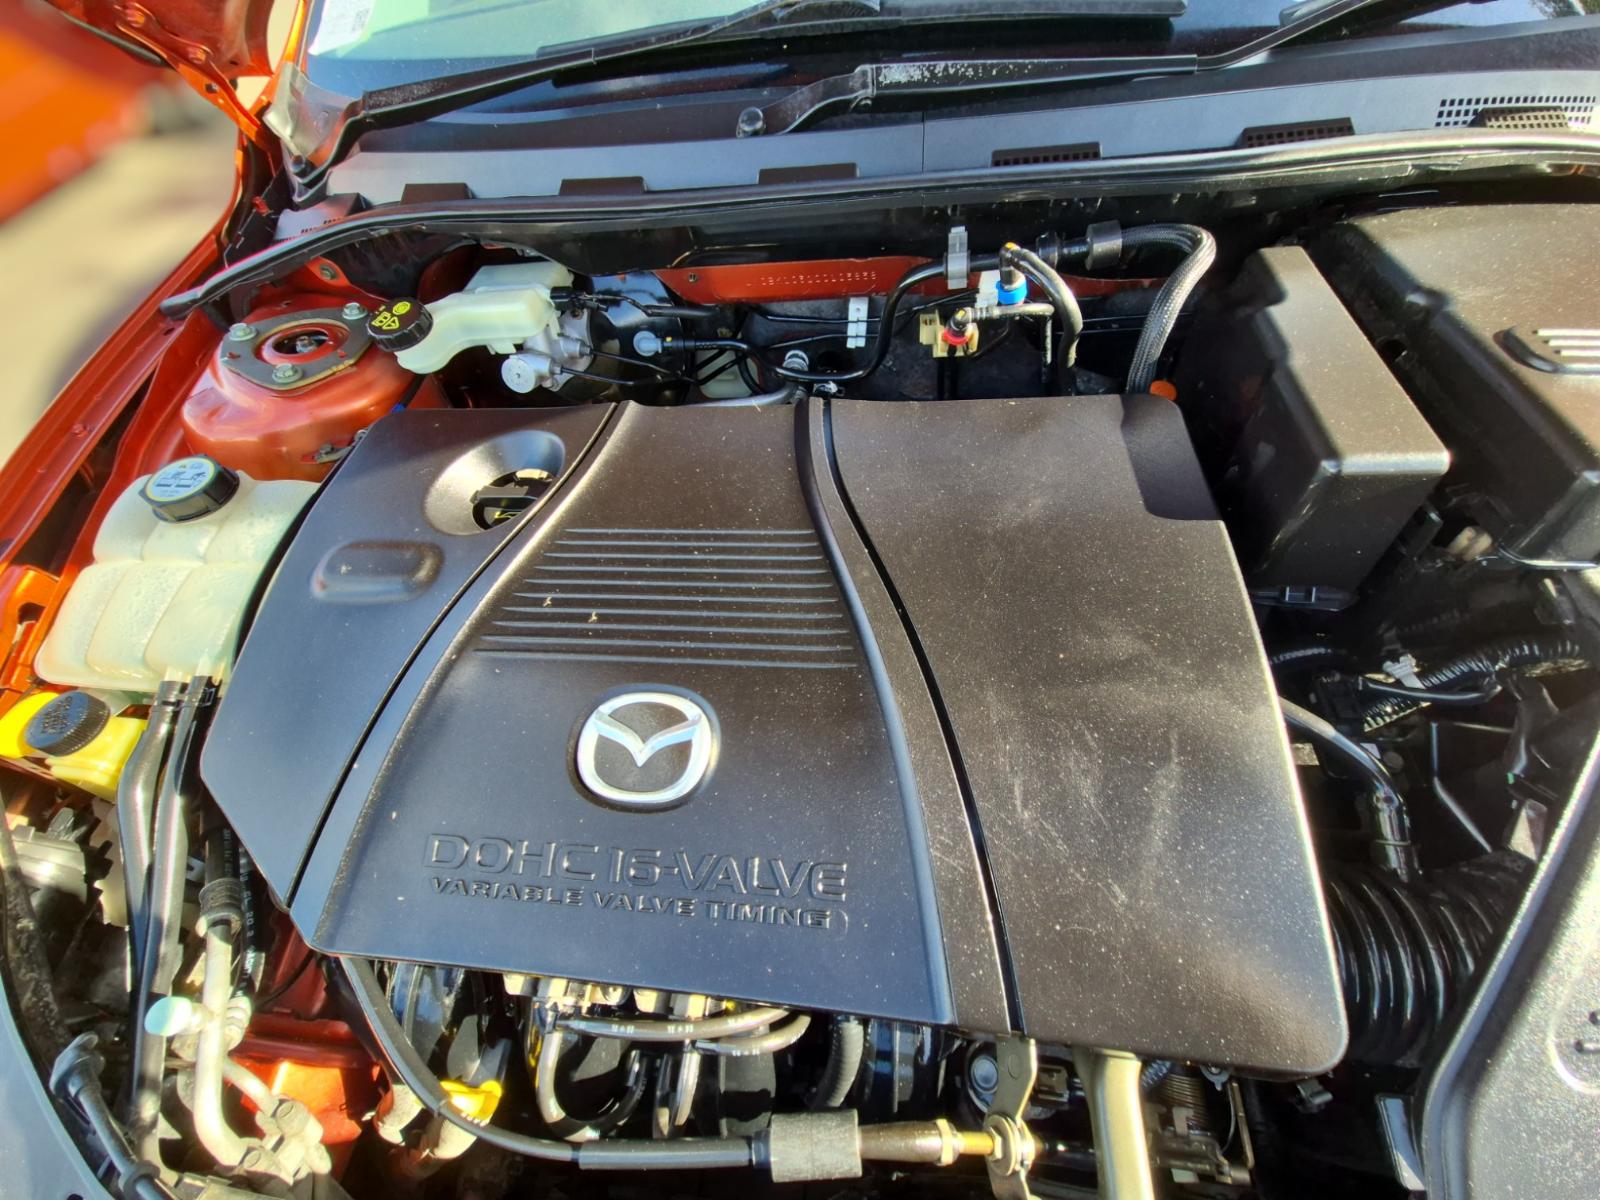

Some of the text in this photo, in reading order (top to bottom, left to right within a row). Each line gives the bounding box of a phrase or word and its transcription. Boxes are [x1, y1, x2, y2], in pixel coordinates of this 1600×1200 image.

[424, 833, 847, 901] DOHC 16-VALVE
[432, 877, 830, 929] VARIABLE VALVE TIMING
